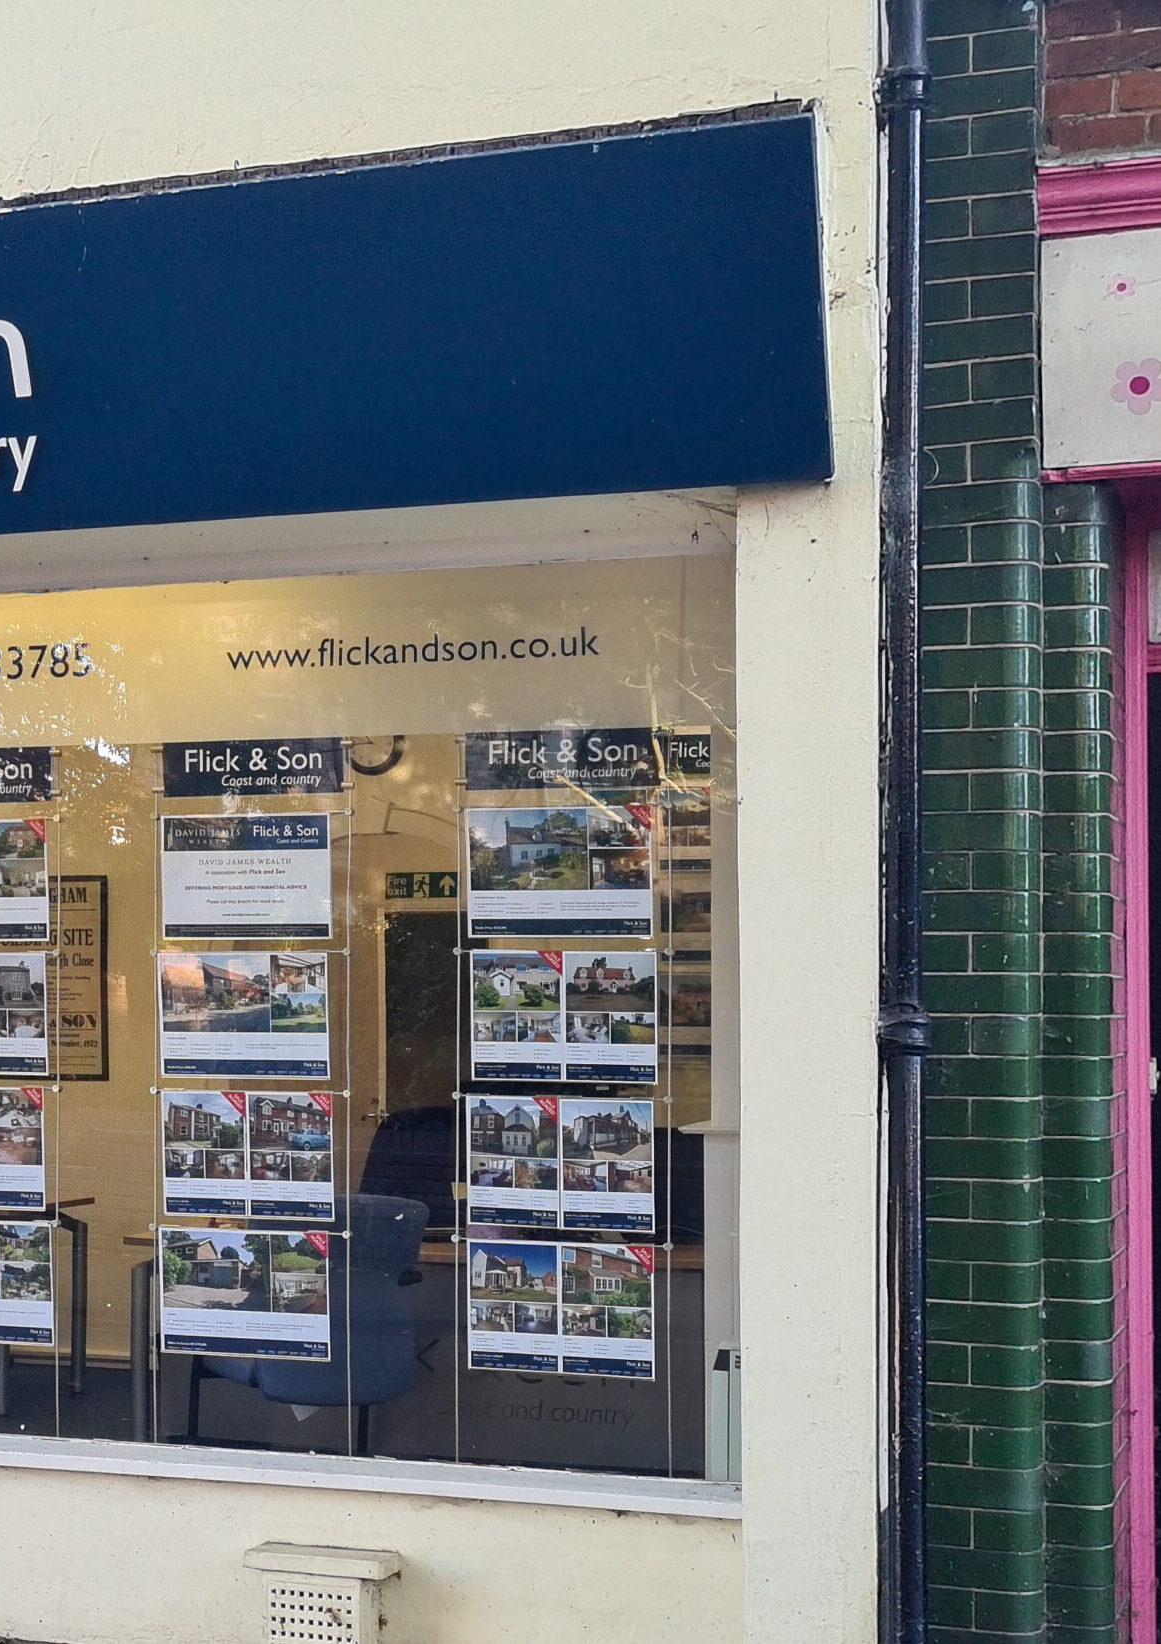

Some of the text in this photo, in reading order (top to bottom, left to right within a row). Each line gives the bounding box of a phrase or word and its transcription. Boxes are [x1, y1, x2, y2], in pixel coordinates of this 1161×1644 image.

[226, 626, 600, 670] www.flickandson.co.uk
[488, 736, 637, 766] Flick & Son
[670, 741, 710, 758] Flick
[184, 746, 322, 773] Flick & Son
[221, 773, 321, 788] Coast and country
[527, 766, 638, 780] Coast and country
[175, 828, 206, 838] DAVID
[253, 824, 319, 838] Flick & Son
[198, 857, 292, 866] DAVID JAMES WEALTH
[387, 875, 407, 886] Fire
[387, 886, 408, 896] exit
[63, 928, 94, 947] SITE
[72, 952, 95, 967] Close
[550, 1404, 635, 1431] country
